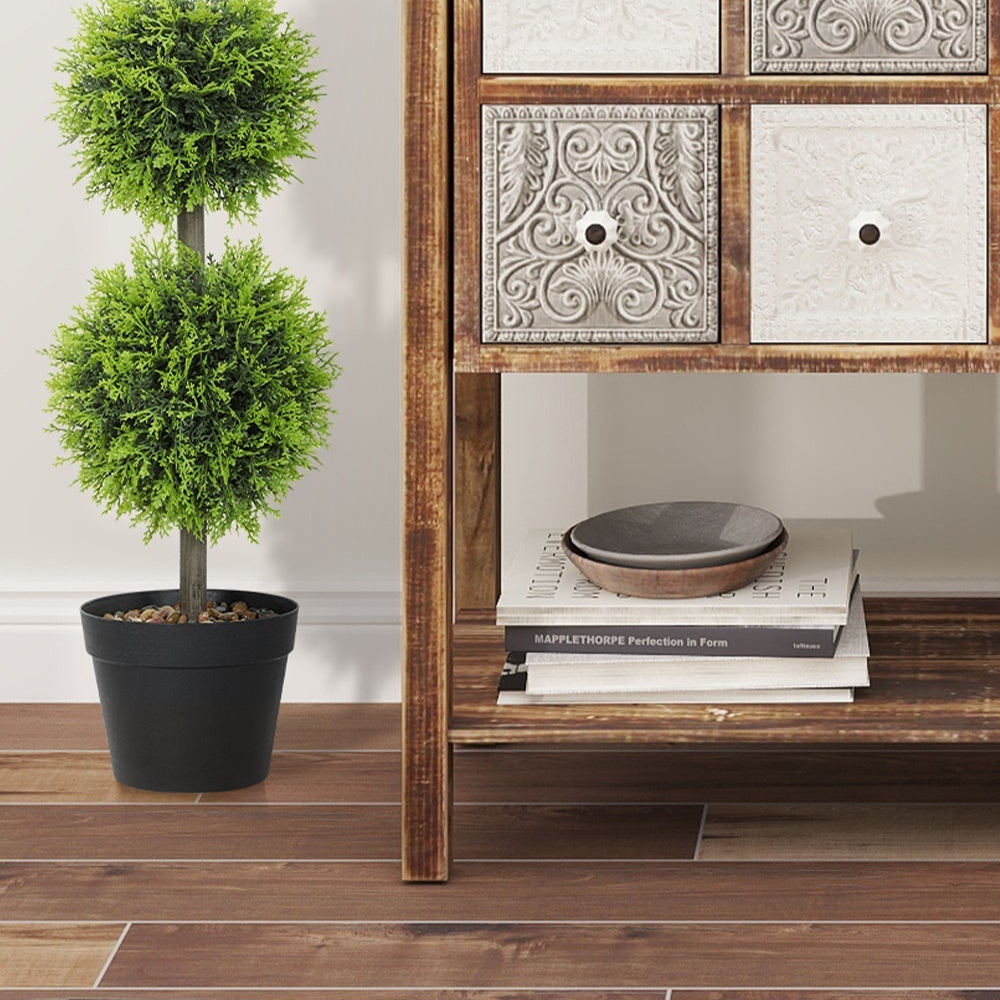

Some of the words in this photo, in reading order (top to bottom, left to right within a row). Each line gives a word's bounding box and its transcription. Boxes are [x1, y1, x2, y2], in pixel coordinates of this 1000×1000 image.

[796, 577, 828, 598] THE
[534, 634, 625, 646] MAPPLETHORPE
[628, 636, 684, 647] Perfection
[686, 636, 697, 647] in
[700, 637, 728, 648] Form
